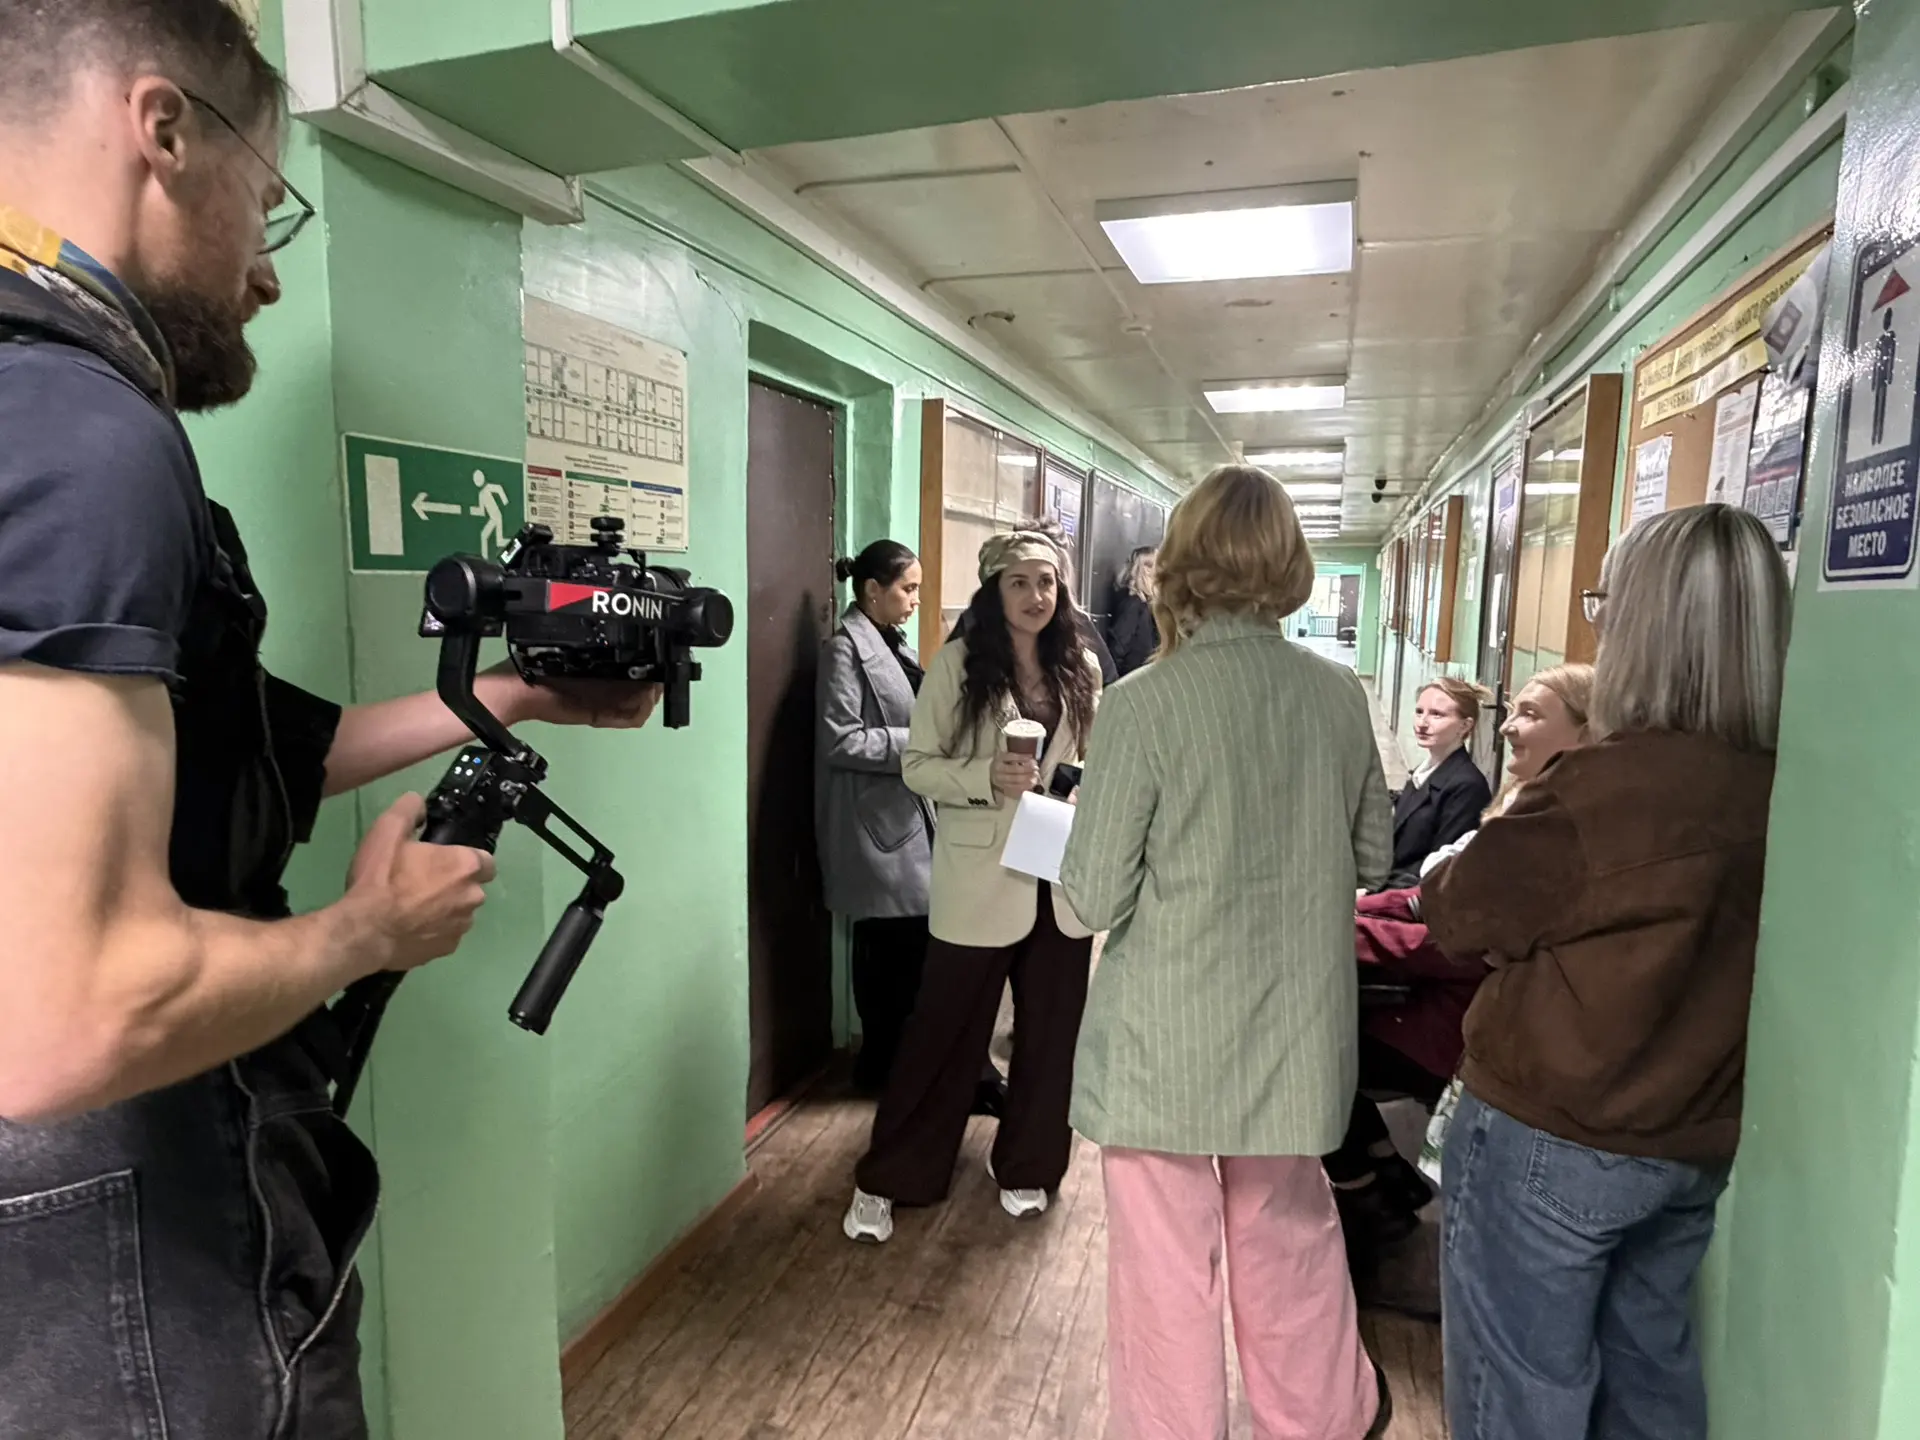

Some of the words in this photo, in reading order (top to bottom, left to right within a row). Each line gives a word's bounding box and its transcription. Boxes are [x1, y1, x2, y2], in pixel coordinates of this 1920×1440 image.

[1844, 459, 1906, 497] НАИБОЛЕЕ
[1835, 493, 1911, 530] БЕЗОПАСНОЕ
[1847, 530, 1887, 558] МЕСТО
[592, 588, 663, 620] RONIN
